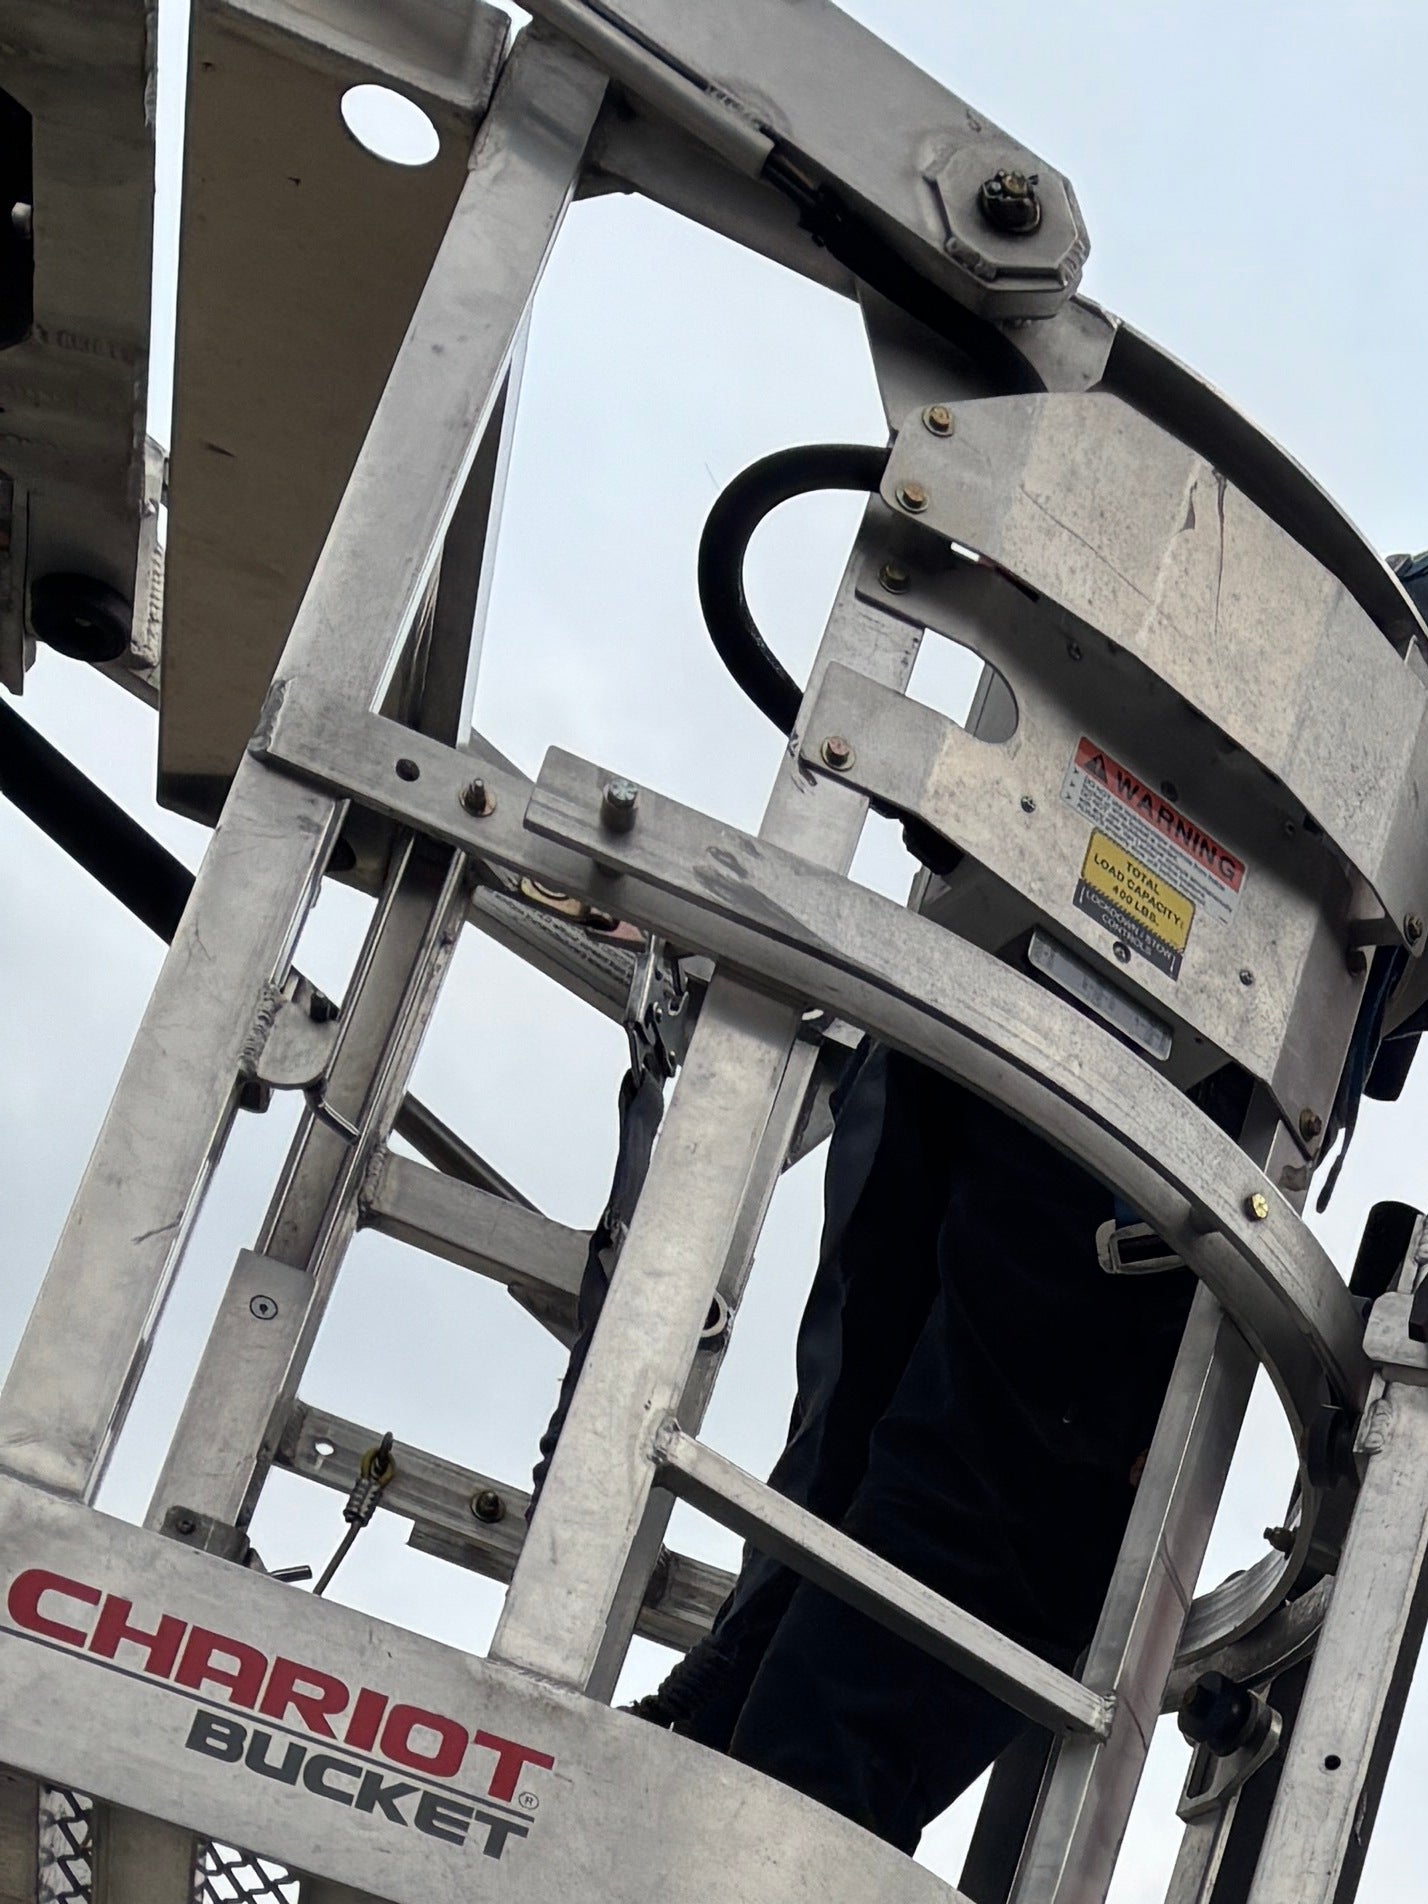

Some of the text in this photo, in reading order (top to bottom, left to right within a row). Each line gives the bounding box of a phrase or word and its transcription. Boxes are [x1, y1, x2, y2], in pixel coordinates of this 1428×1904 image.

[1116, 770, 1236, 883] WARNING
[1094, 853, 1125, 884] LOAD
[1127, 879, 1185, 929] CAPACITY:
[1112, 885, 1133, 905] 400
[1126, 861, 1160, 896] TOTAL
[1102, 914, 1153, 956] CONTROLS
[7, 1568, 556, 1803] CHARIOT
[185, 1708, 530, 1860] BUCKET
